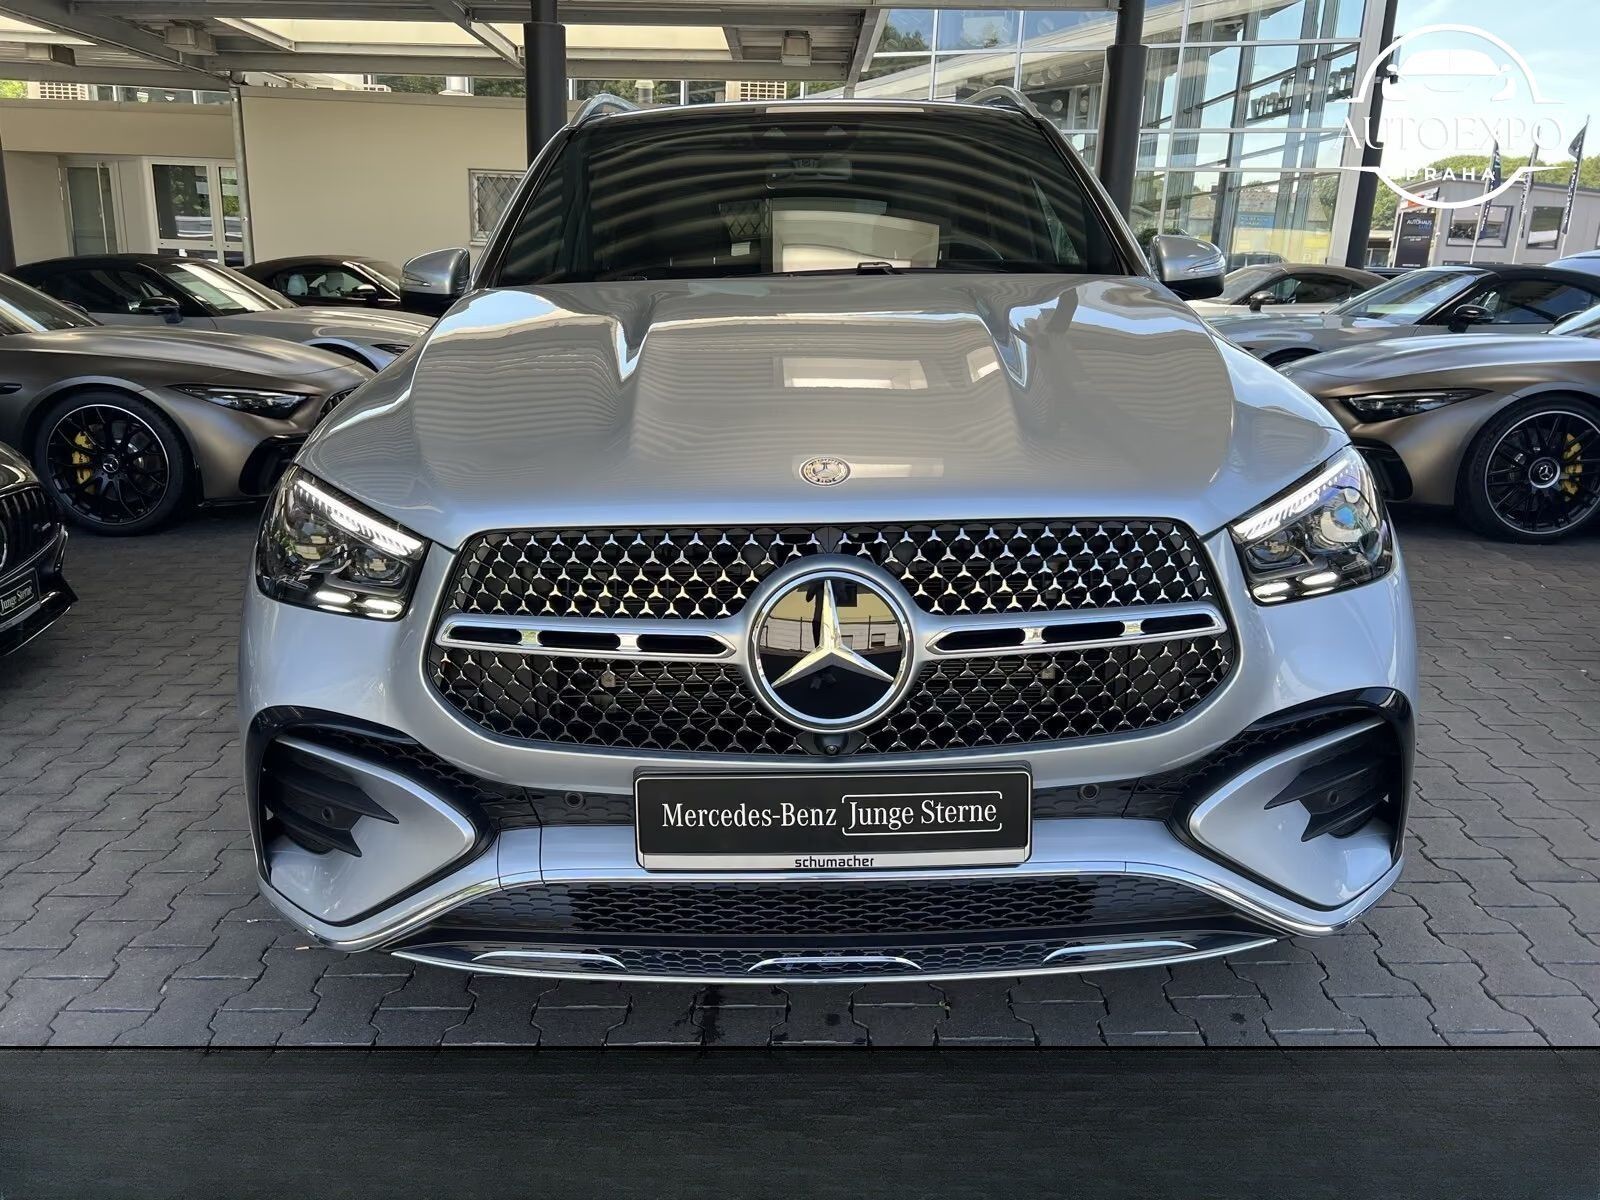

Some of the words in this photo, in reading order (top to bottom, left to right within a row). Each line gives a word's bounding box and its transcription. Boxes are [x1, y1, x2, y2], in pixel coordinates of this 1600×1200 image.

[662, 802, 837, 828] Mercedes-Benz
[847, 801, 915, 830] Junge
[920, 800, 997, 824] Sterne
[795, 855, 875, 868] schumacher
